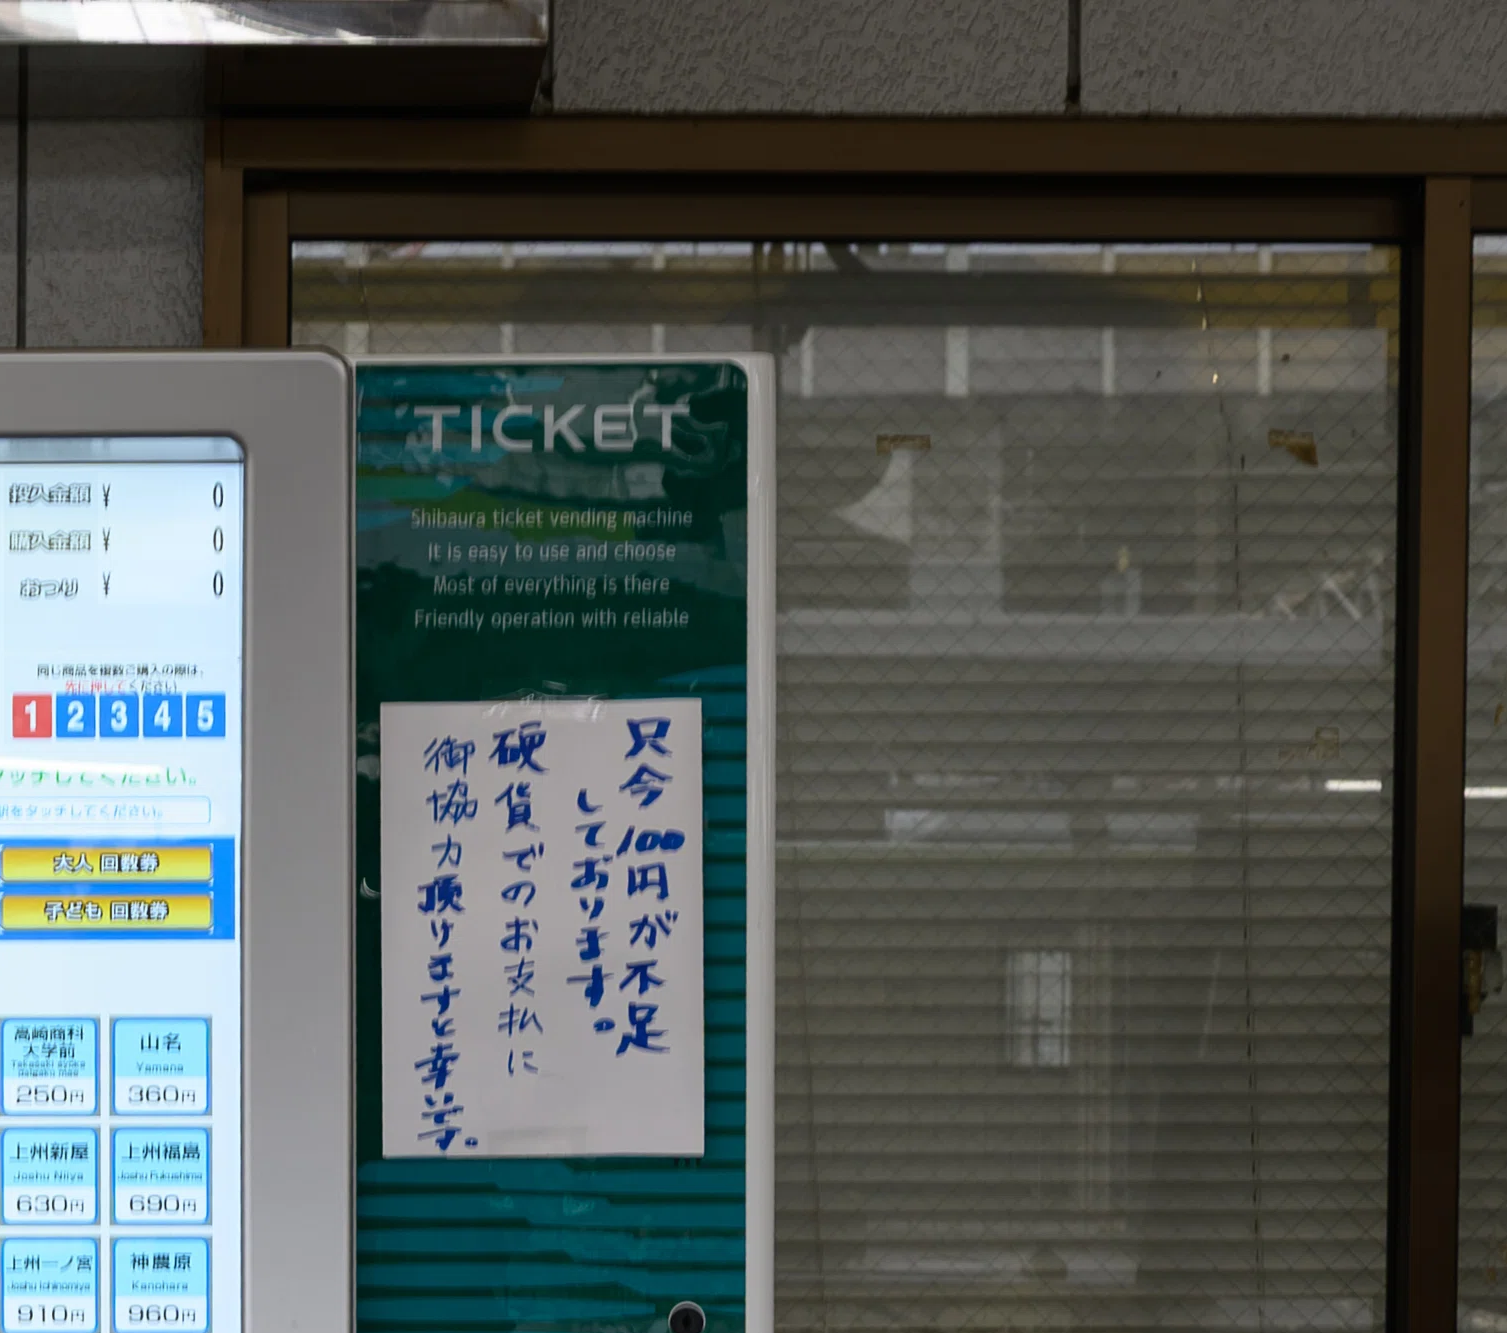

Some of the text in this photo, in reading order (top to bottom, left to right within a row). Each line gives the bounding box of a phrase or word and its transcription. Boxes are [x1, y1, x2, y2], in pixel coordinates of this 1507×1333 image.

[413, 403, 691, 452] TICKET
[213, 481, 224, 508] 0
[411, 508, 693, 532] Shibaura ticket vending machine
[213, 526, 224, 552] 0
[428, 542, 676, 566] It is easy to use and choose
[213, 570, 224, 597] 0
[434, 575, 670, 600] Most of everything is there
[414, 609, 689, 633] Friendly operation with reliable
[23, 701, 215, 732] 1 2 3 4 5
[53, 853, 160, 874] 大人 回数券
[44, 901, 170, 922] 子ども 回数券
[14, 1024, 84, 1041] 高崎商科
[140, 1031, 182, 1052] 山名
[23, 1042, 76, 1059] 大学前
[16, 1084, 84, 1105] 250円
[128, 1084, 196, 1105] 360円
[10, 1141, 90, 1162] 上州新屋
[121, 1141, 201, 1162] 上州福島
[16, 1194, 84, 1215] 630円
[129, 1194, 197, 1215] 690円
[6, 1253, 93, 1272] 上州一ノ宮
[131, 1251, 193, 1271] 神農原
[17, 1303, 85, 1324] 910円
[128, 1303, 196, 1324] 960円
